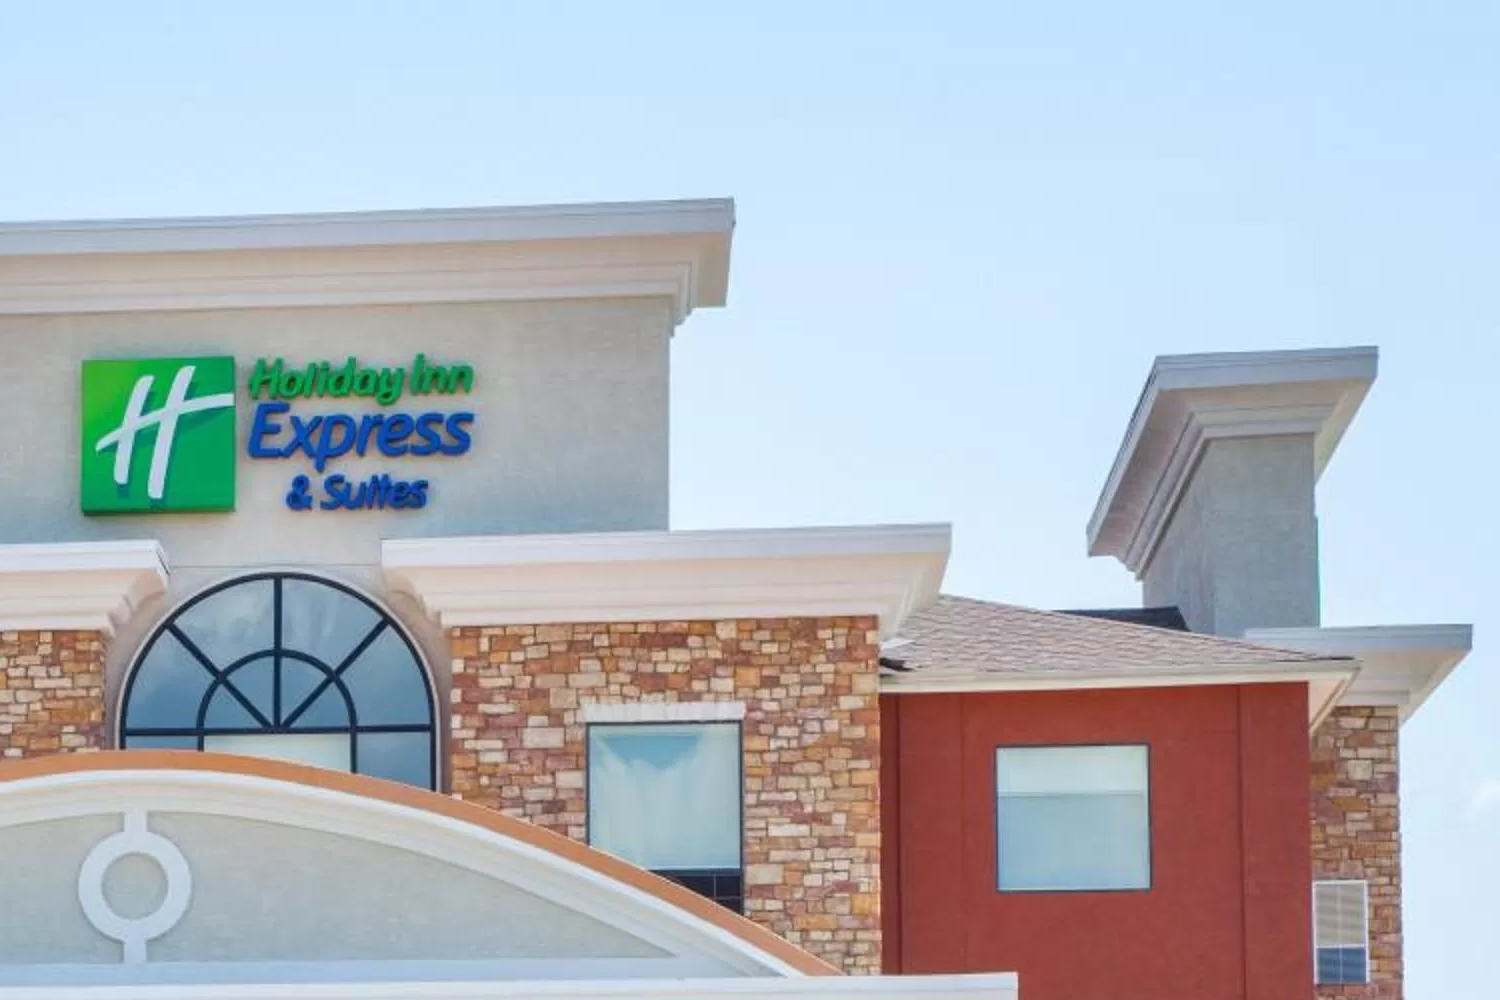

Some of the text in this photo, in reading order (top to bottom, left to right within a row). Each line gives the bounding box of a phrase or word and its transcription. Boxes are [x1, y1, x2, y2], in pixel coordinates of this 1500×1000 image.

[249, 354, 474, 405] Holiday Inn
[247, 402, 476, 472] Express
[286, 474, 429, 510] & Suites
